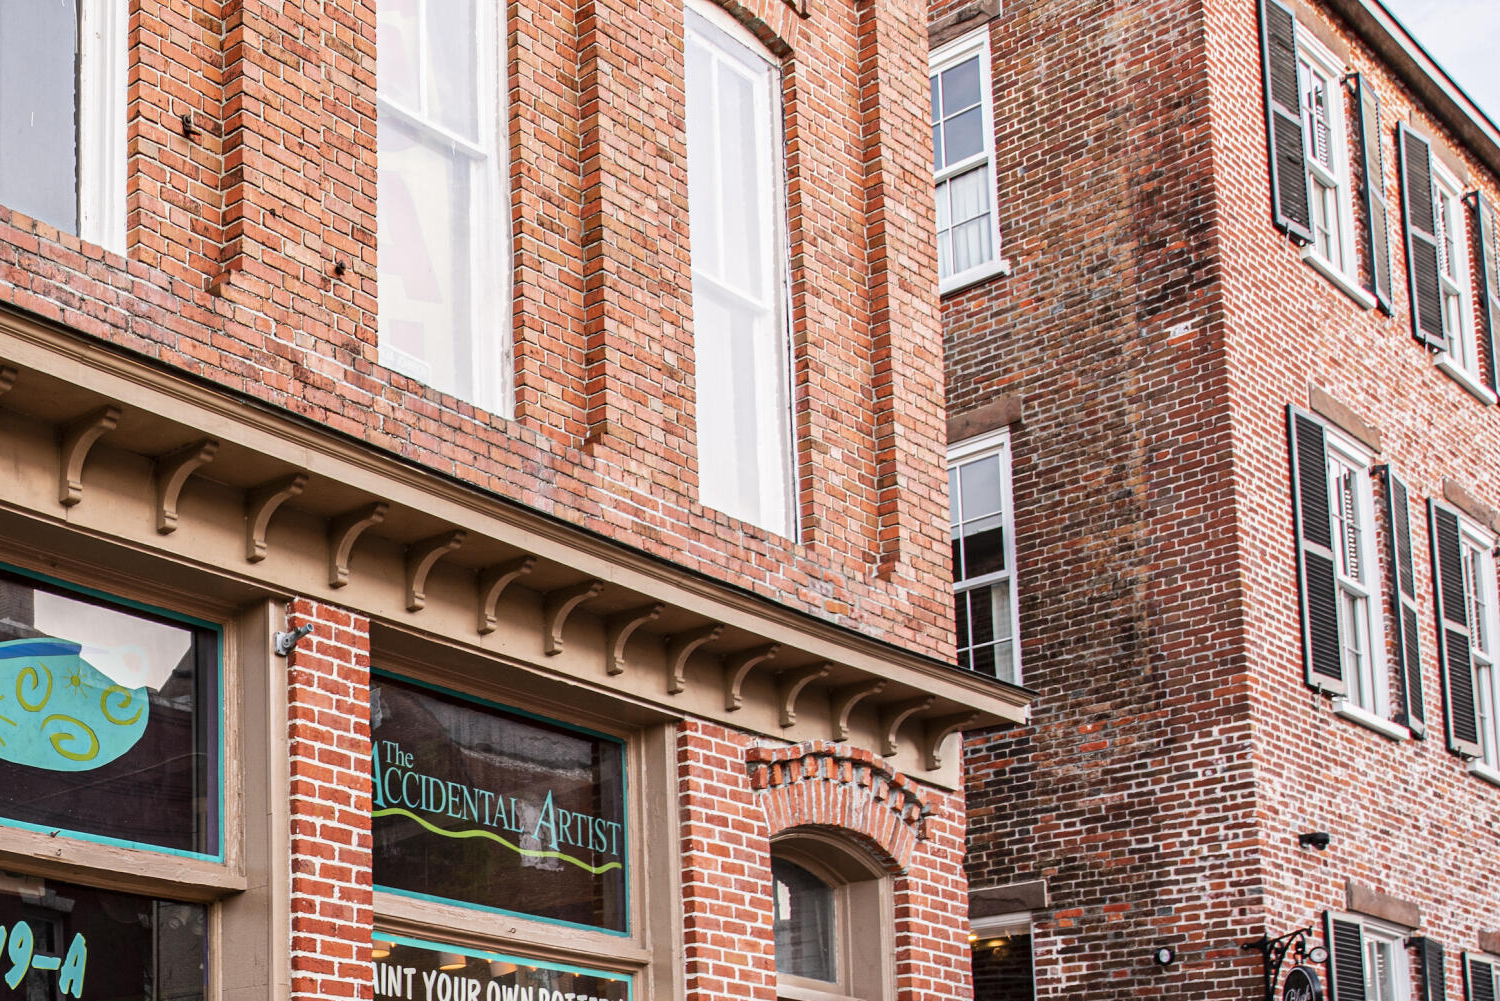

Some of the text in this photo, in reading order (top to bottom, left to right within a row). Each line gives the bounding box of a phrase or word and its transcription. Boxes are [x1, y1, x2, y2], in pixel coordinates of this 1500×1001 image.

[383, 740, 414, 769] The
[532, 789, 621, 856] ARTIST
[372, 962, 416, 999] AINT
